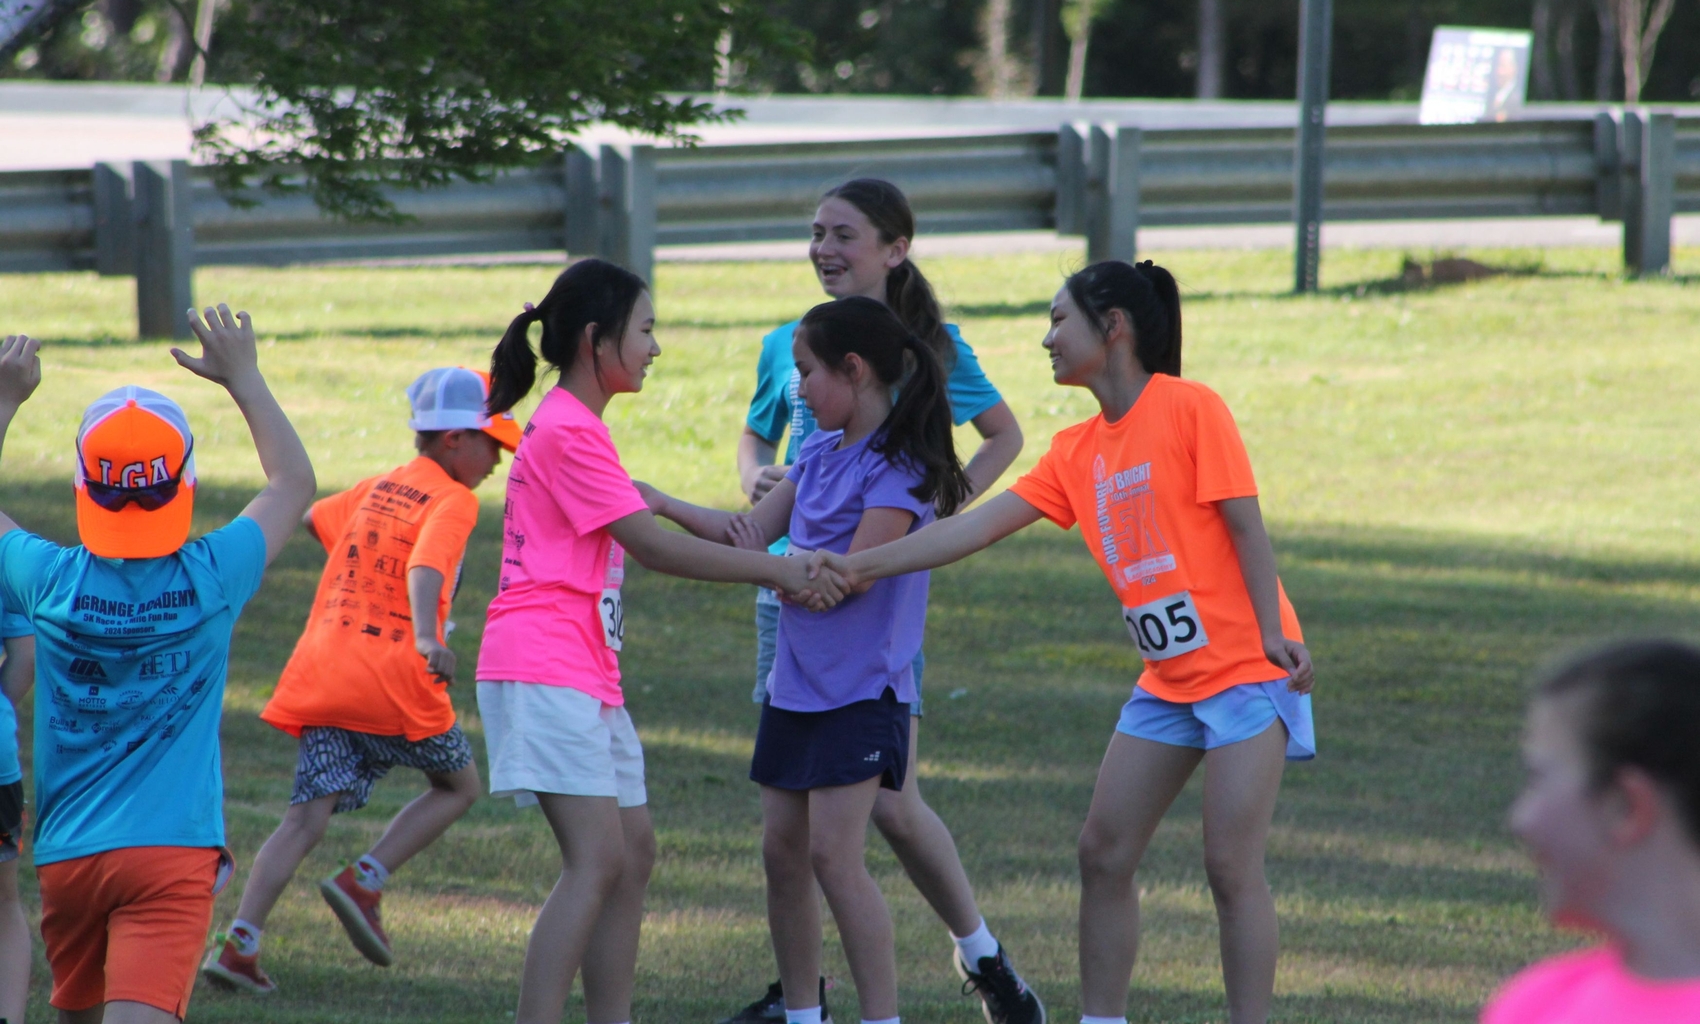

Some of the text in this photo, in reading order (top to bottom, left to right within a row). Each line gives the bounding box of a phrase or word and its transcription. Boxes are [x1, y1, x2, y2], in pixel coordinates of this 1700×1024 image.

[790, 409, 804, 437] OUR
[98, 455, 171, 488] LGA
[1114, 462, 1152, 490] BRIGHT
[1094, 480, 1119, 565] OUR FUTURE
[1107, 489, 1170, 563] 5K
[71, 588, 196, 617] AGRANGE ACADEMY
[83, 613, 94, 622] 5K
[95, 616, 116, 625] Race
[129, 614, 147, 623] Mile
[147, 613, 162, 622] Fun
[163, 612, 178, 620] Run
[104, 625, 155, 635] 2024 Sponsors
[1125, 600, 1197, 652] 205
